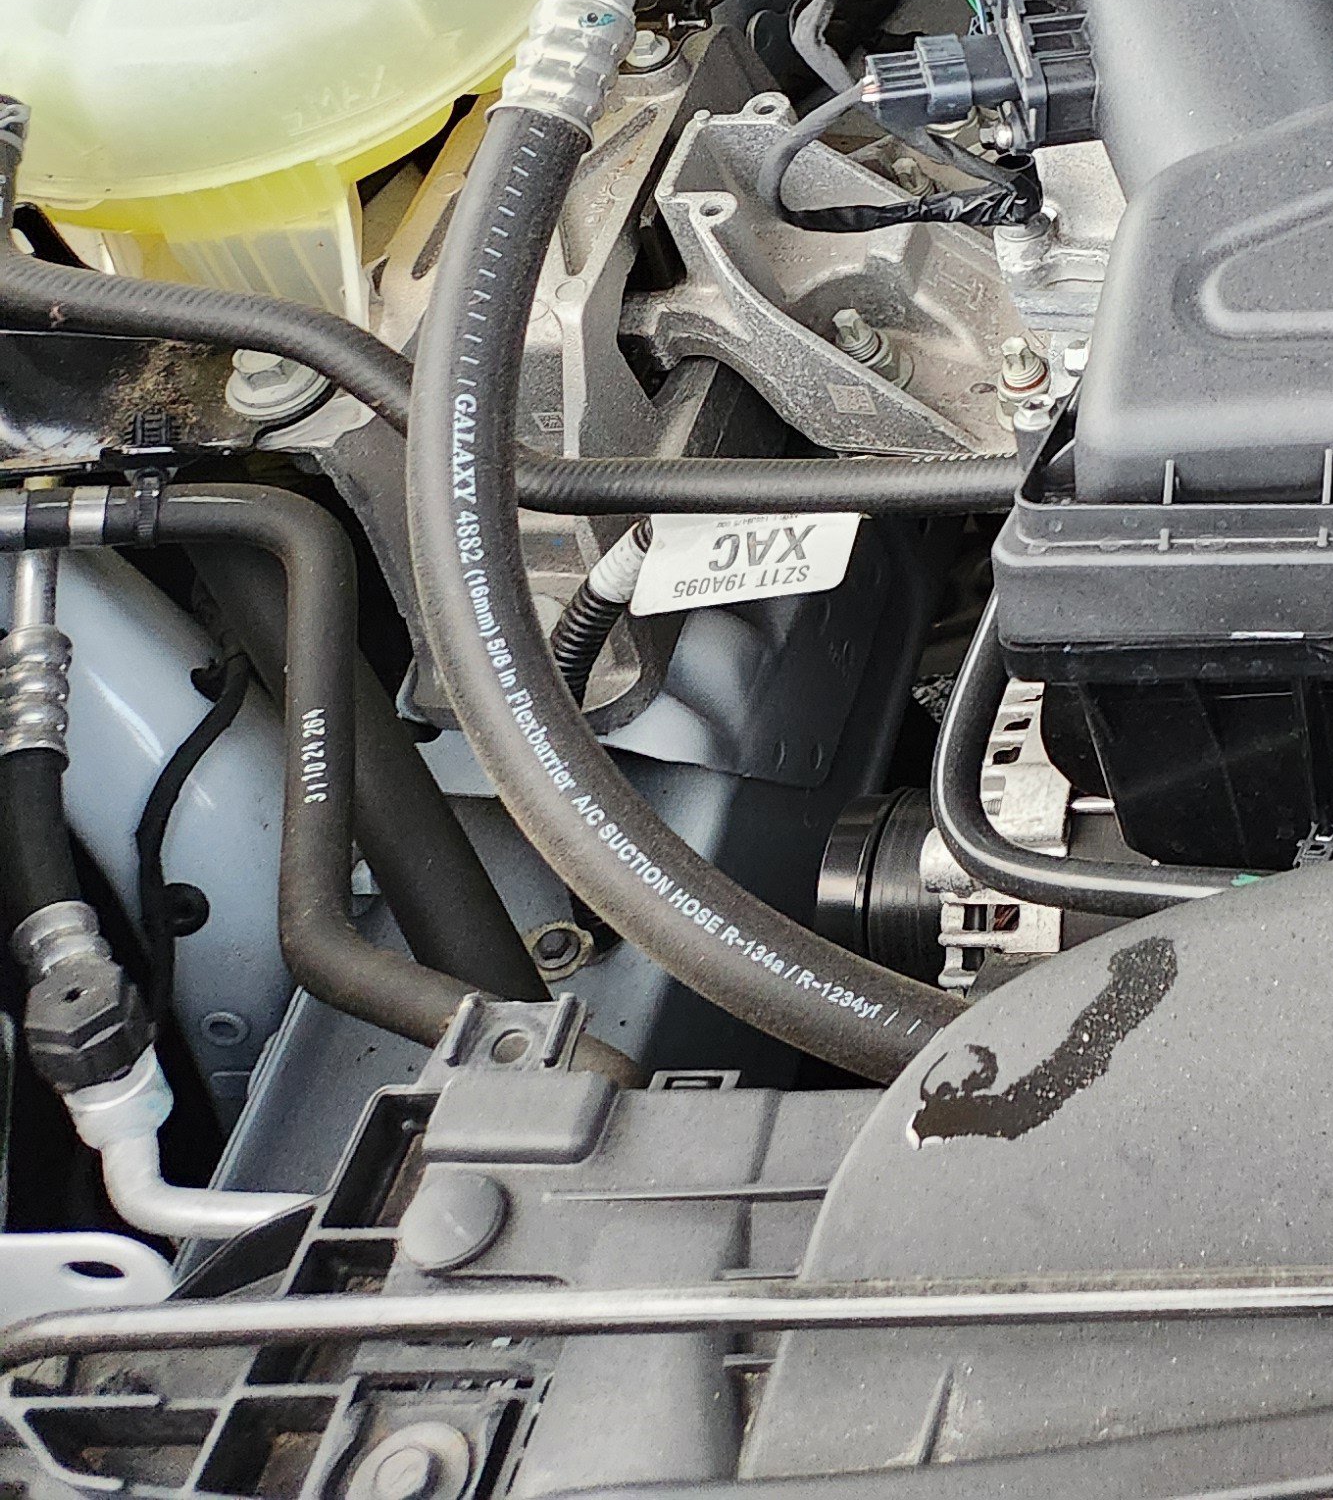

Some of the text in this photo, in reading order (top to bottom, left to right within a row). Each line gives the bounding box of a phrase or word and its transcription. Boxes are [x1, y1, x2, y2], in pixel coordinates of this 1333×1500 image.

[451, 394, 477, 504] GALAXY
[455, 506, 482, 569] 4882
[708, 524, 816, 572] XAC
[465, 568, 496, 640] (16mm)
[671, 564, 810, 599] SZ1T 19A095
[485, 635, 509, 671] 5/8
[505, 689, 578, 792] Flexbarrier
[572, 792, 609, 832] A/C
[598, 819, 671, 898] SUCTION
[669, 886, 724, 939] HOSE
[720, 925, 786, 975] R-134a
[795, 966, 884, 1023] R-1234yf
